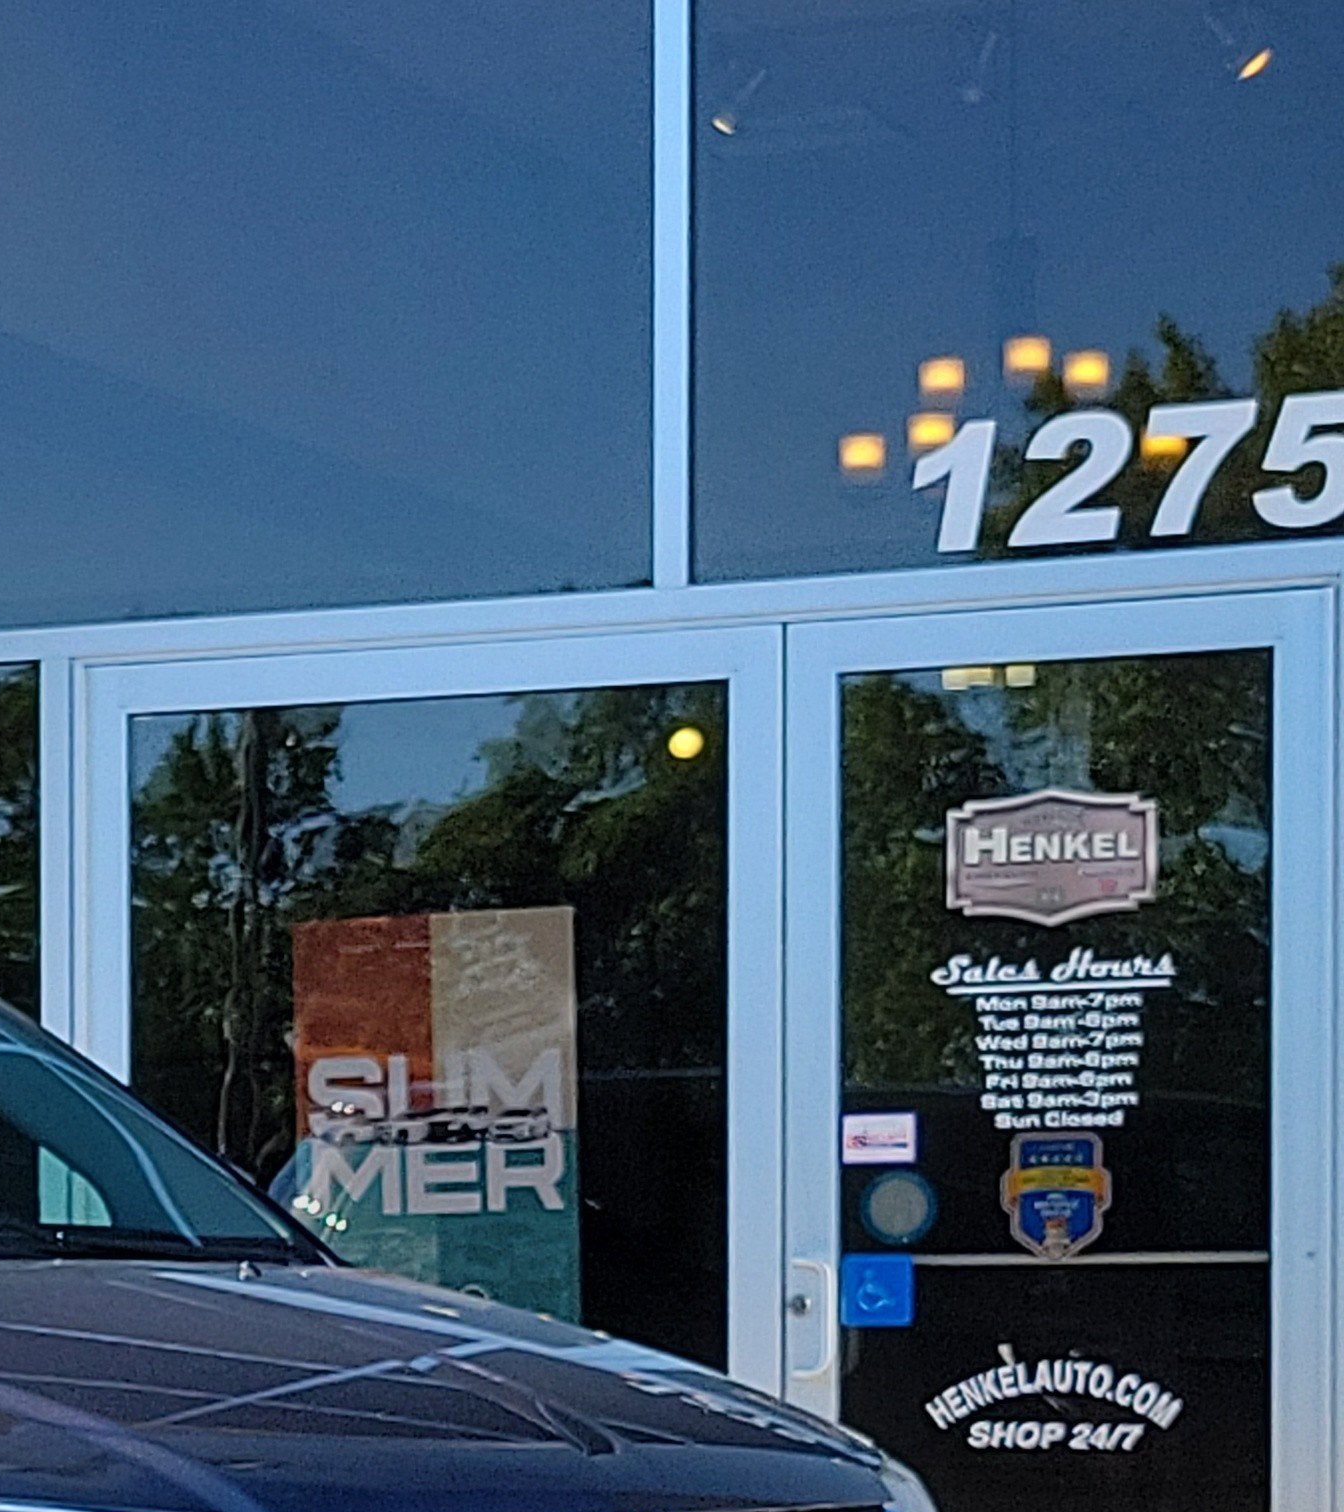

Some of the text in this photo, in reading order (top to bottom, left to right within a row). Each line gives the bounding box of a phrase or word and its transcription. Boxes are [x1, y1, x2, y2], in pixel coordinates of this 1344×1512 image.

[913, 391, 1344, 553] 1275
[964, 827, 1140, 865] HENKEL
[930, 946, 1177, 986] Sales Hours
[975, 996, 1028, 1012] Mon
[978, 1014, 1021, 1031] Tue
[974, 1033, 1029, 1051] Wed
[978, 1053, 1024, 1071] Thu
[985, 1073, 1019, 1090] Fri
[980, 1093, 1024, 1110] Sat
[994, 1109, 1125, 1129] Sun Closed
[308, 1132, 565, 1216] MER
[925, 1359, 1184, 1430] HENKELAUTO.COM
[967, 1419, 1146, 1451] SHOP 24/7
